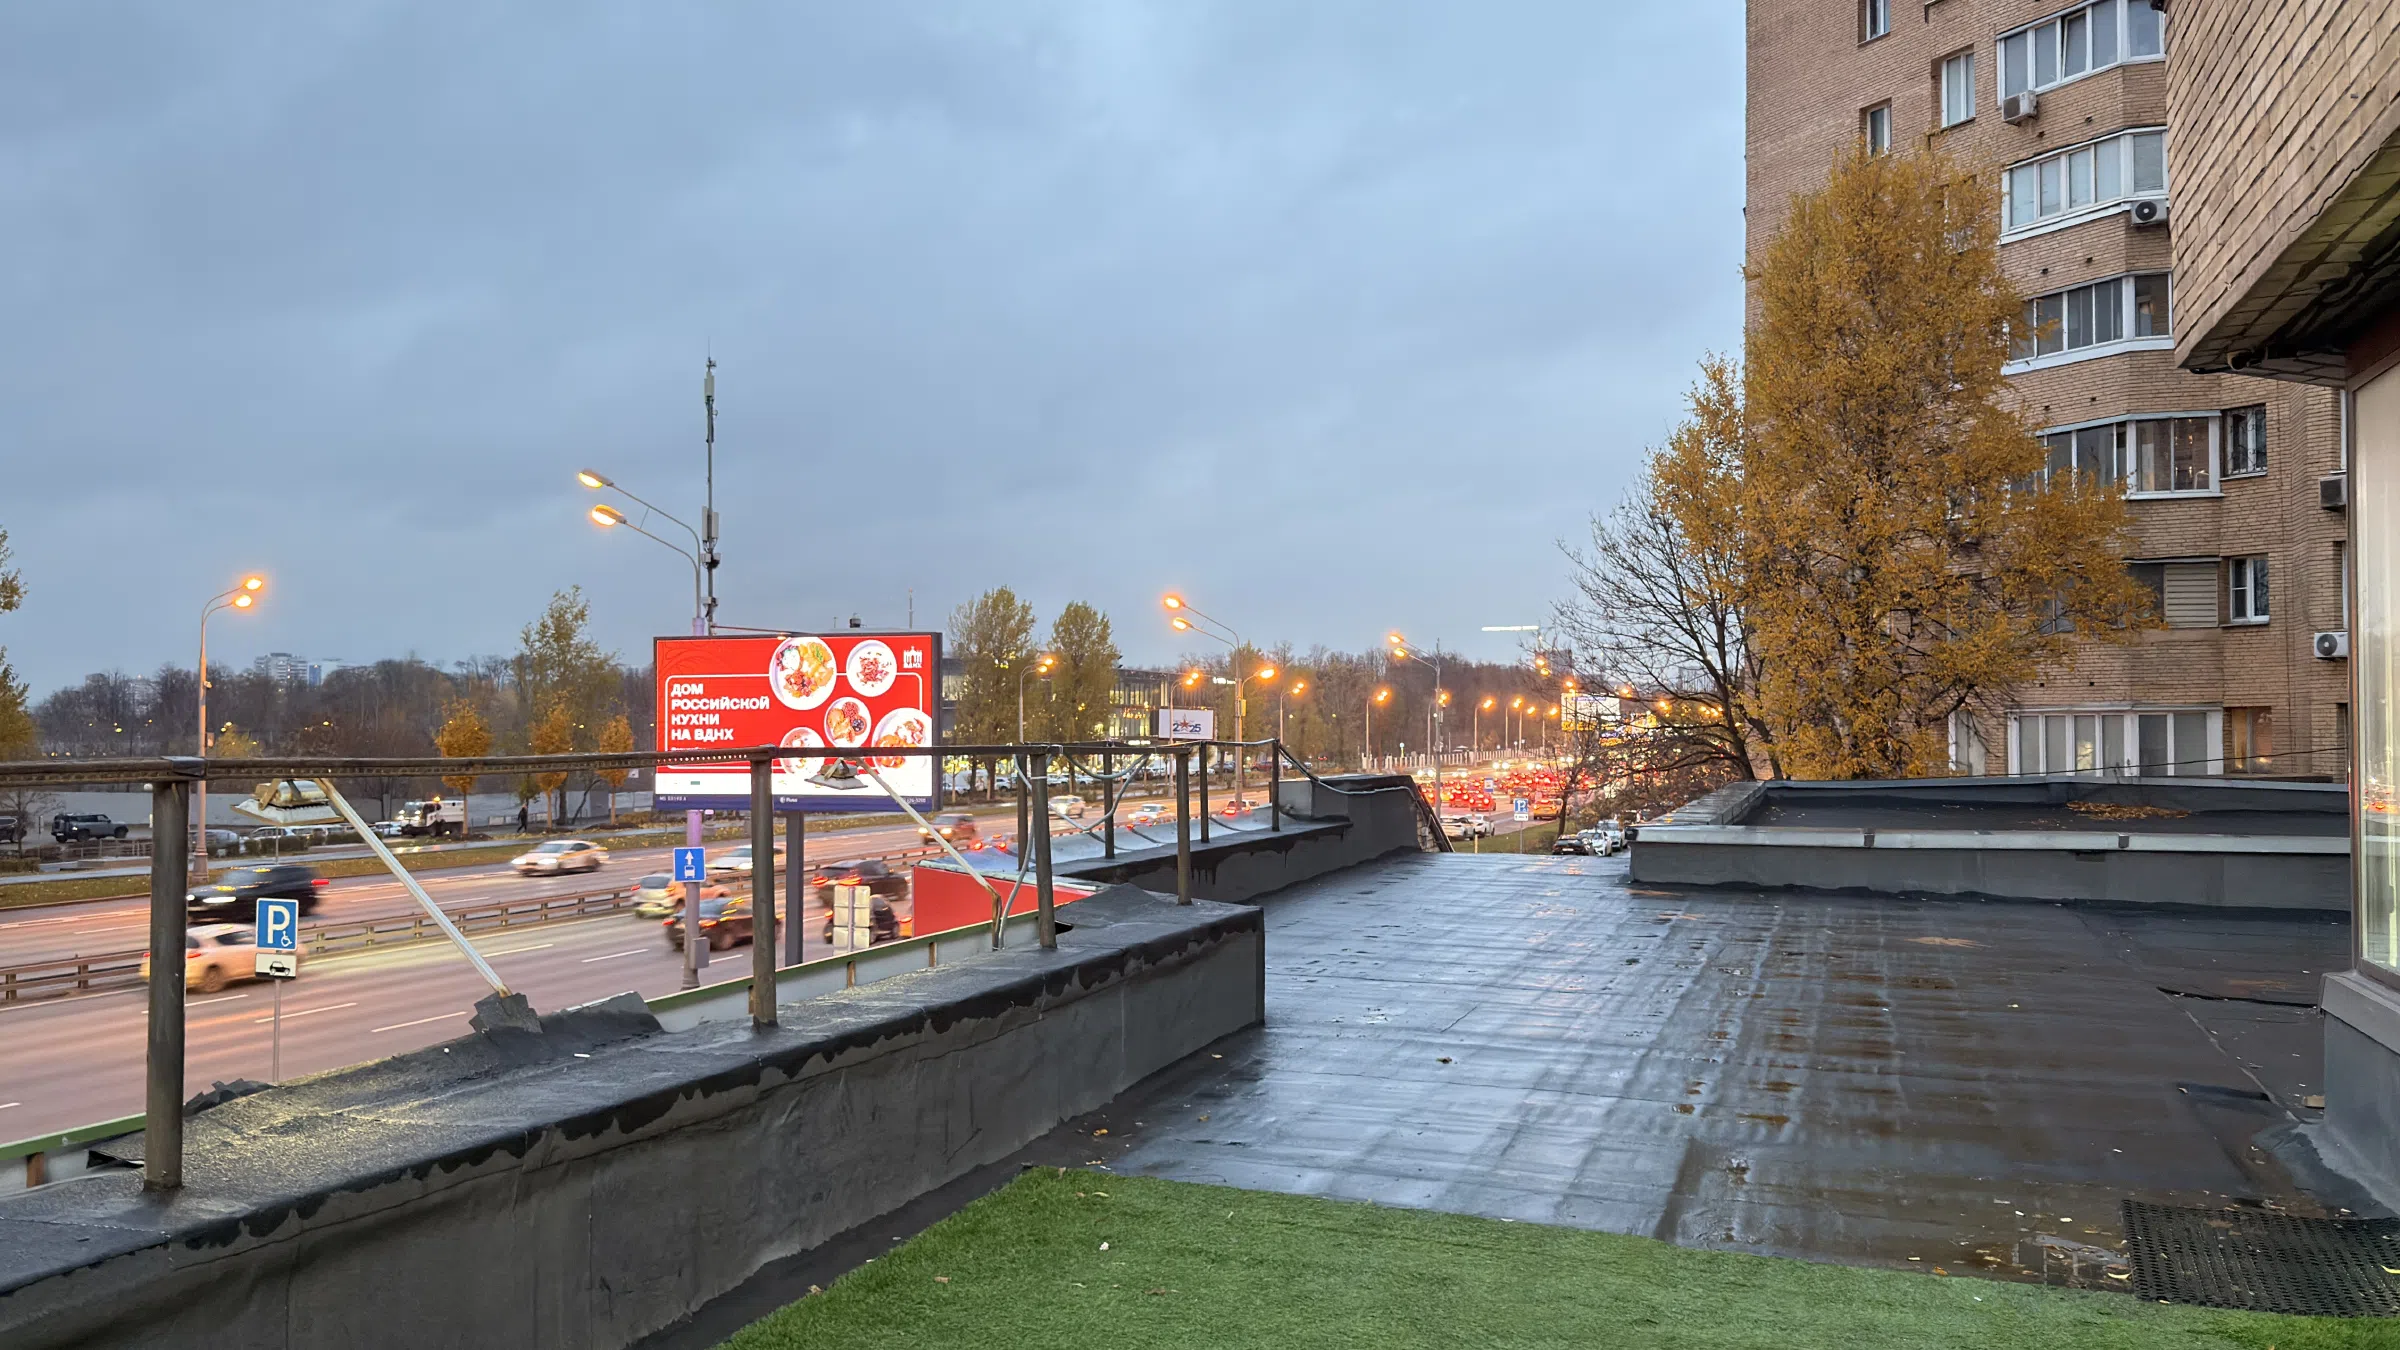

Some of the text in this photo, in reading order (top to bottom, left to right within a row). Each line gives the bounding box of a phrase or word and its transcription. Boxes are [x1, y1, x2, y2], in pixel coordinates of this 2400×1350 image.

[671, 683, 704, 697] ДОМ
[671, 696, 770, 710] РОССИЙСКОЙ
[671, 713, 720, 725] КУХНИ
[671, 728, 734, 742] НА ВДНХ
[267, 905, 290, 944] P
